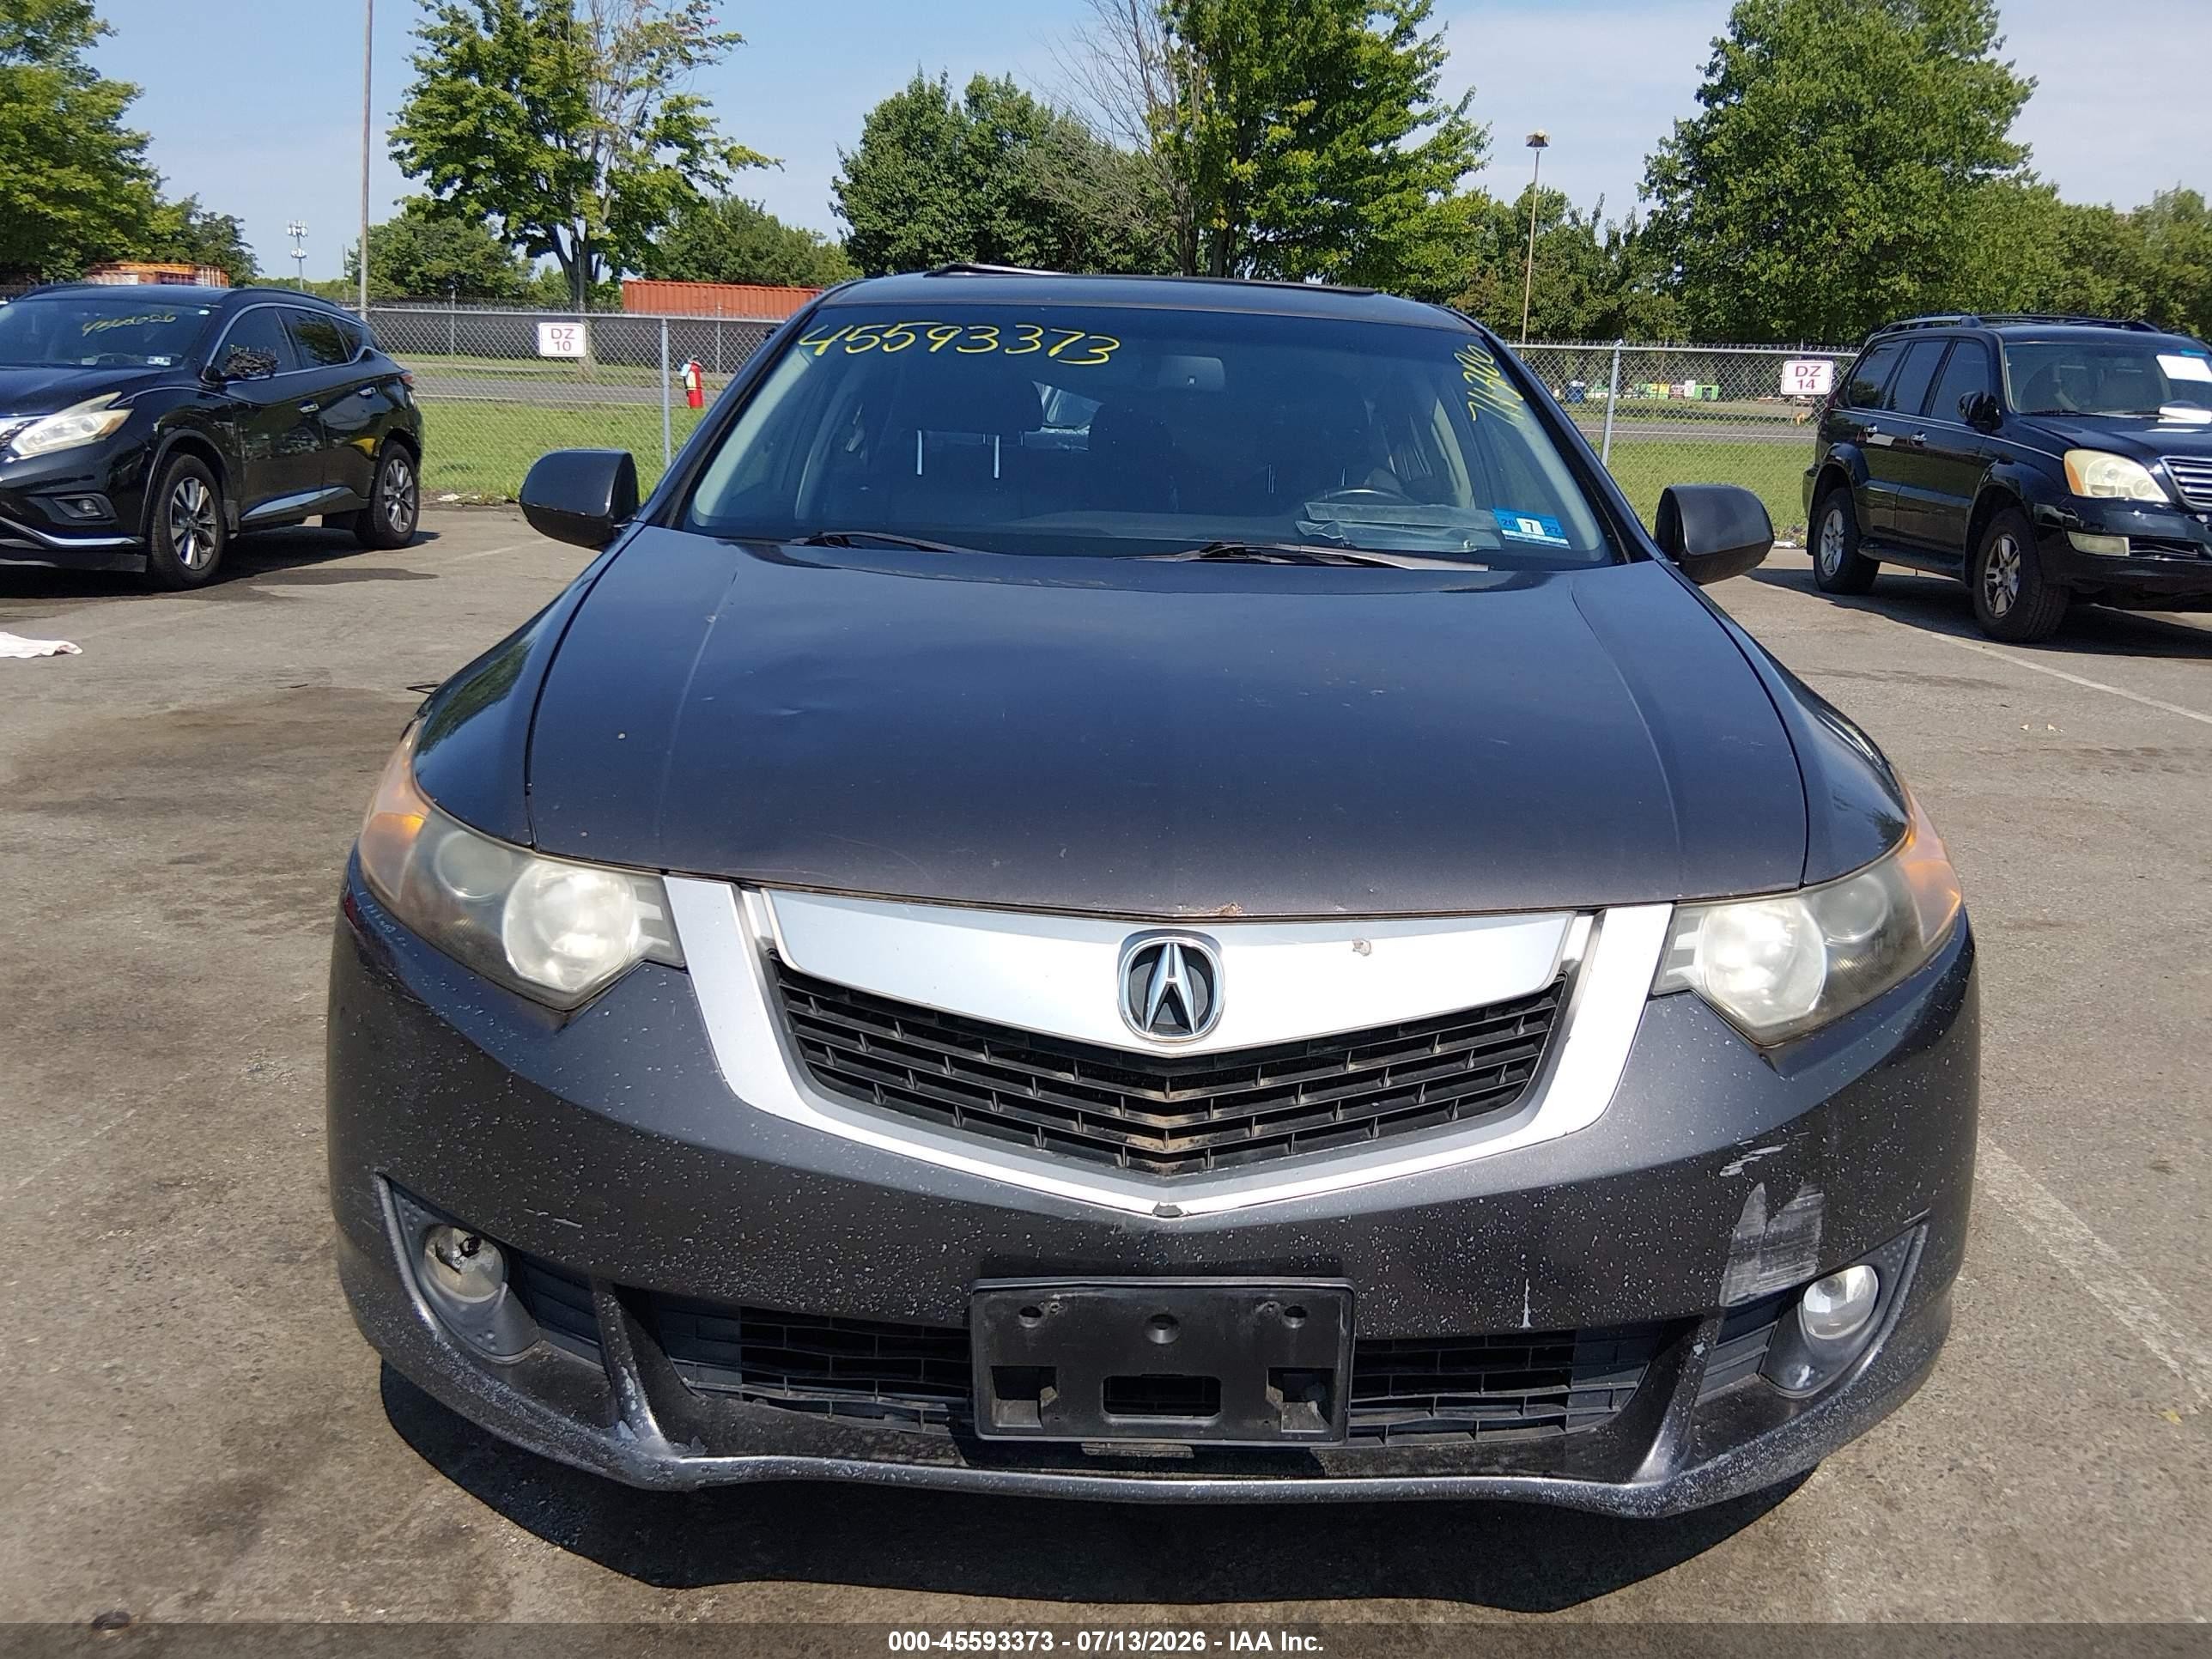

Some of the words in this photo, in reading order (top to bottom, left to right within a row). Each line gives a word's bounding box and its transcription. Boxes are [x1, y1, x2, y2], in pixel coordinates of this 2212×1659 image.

[550, 328, 575, 339] DZ
[554, 341, 571, 351] 10
[798, 321, 1120, 366] 45593373
[1795, 366, 1821, 377] DZ
[1796, 379, 1815, 390] 14
[1524, 520, 1534, 533] 7
